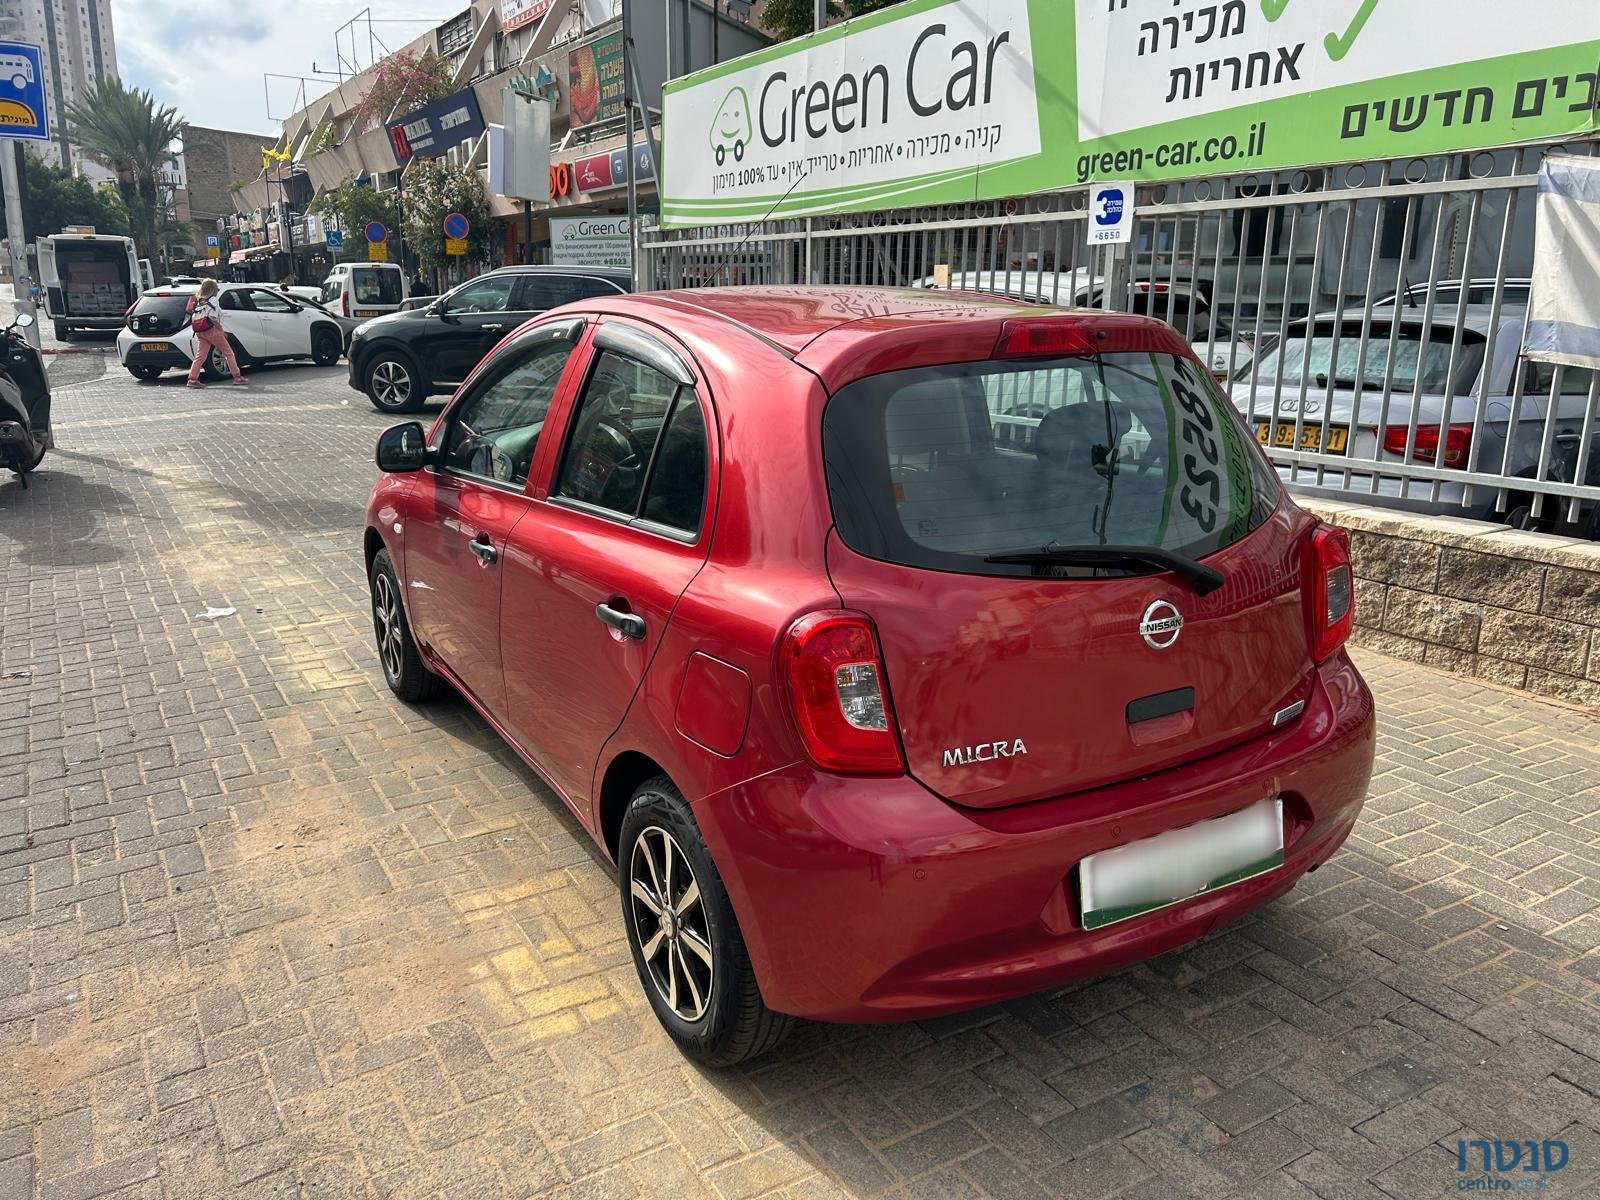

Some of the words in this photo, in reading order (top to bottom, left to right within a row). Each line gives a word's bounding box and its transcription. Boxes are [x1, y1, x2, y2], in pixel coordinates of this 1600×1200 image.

[1137, 0, 1246, 56] מכירה
[758, 64, 889, 148] Green
[906, 23, 1010, 117] Car
[1165, 42, 1305, 103] אחריות
[1340, 86, 1494, 139] חדשים
[906, 133, 950, 159] מכירה
[965, 124, 1001, 153] קניה
[806, 153, 837, 174] טרייד
[847, 142, 894, 168] אחריות
[1076, 121, 1266, 183] green-car.co.il
[713, 172, 735, 195] מימון
[738, 166, 764, 186] 100%
[766, 164, 779, 181] עד
[788, 160, 803, 183] אין
[578, 221, 615, 236] Green
[1146, 618, 1182, 632] NISSAN
[942, 738, 1028, 767] MICRA
